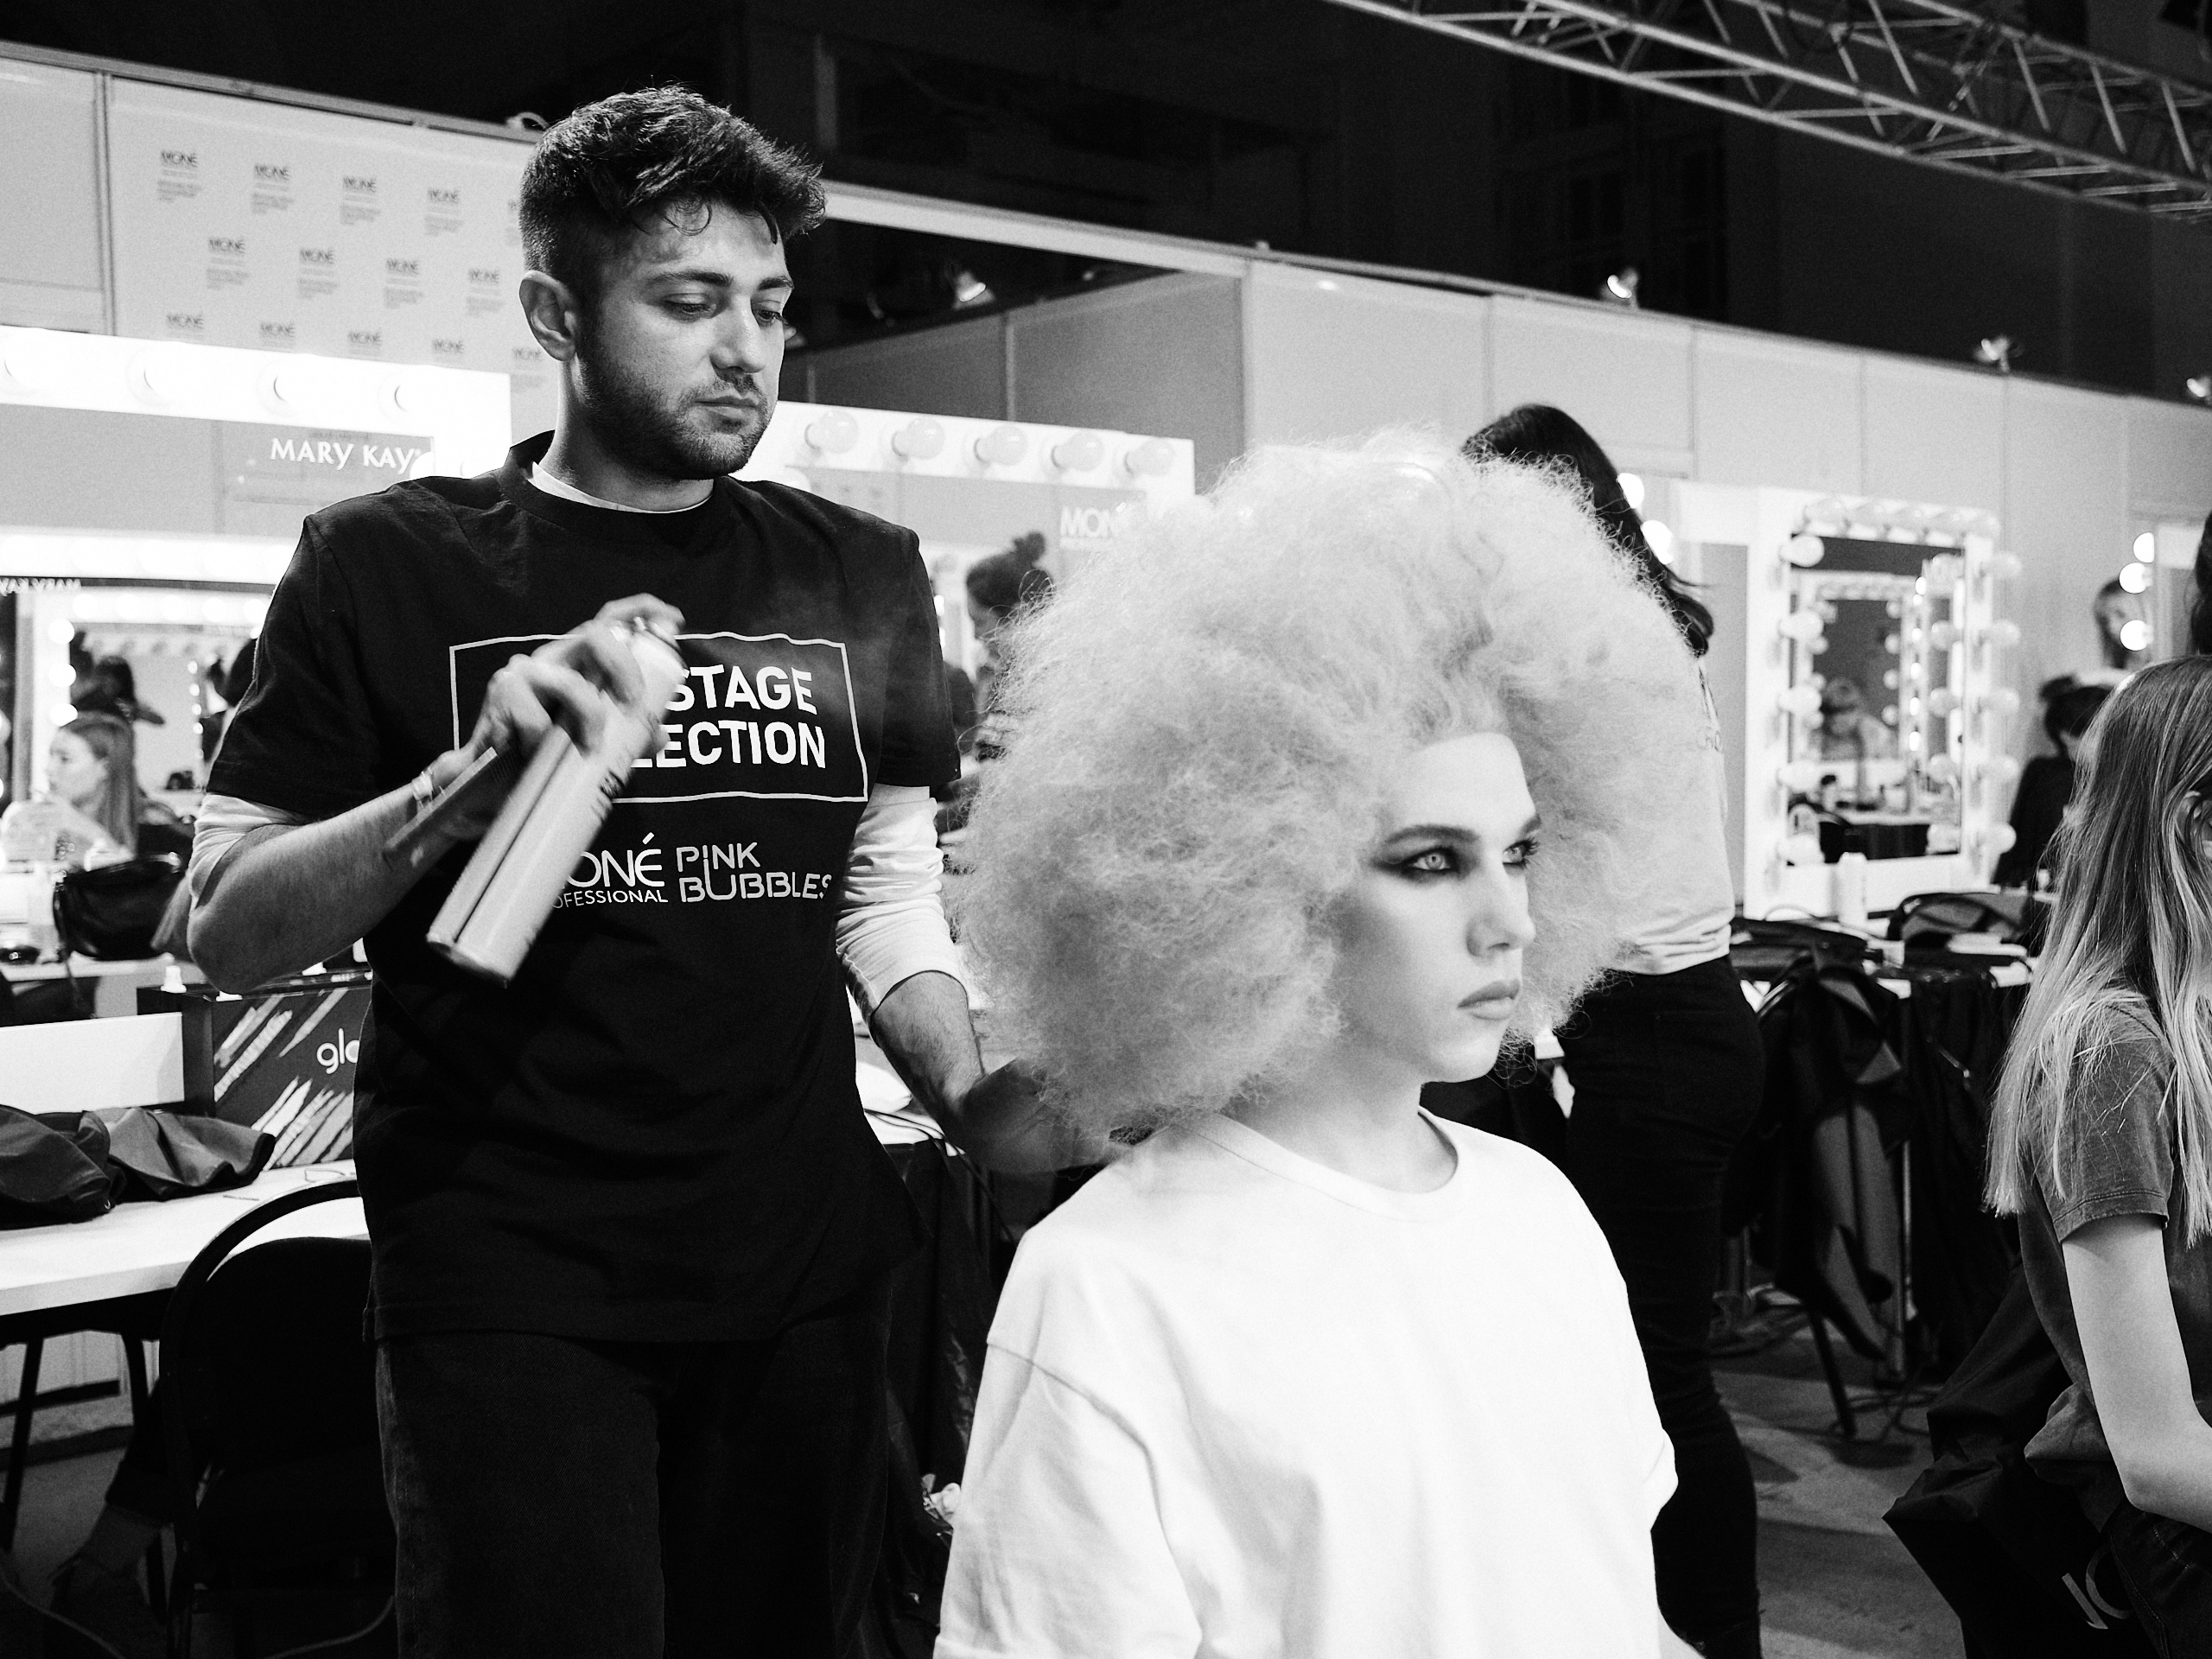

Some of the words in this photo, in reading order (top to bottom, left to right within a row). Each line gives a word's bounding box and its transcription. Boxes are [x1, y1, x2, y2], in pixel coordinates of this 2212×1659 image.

[270, 437, 354, 471] MARY
[1060, 505, 1122, 538] MON
[562, 831, 665, 889] ONÉ
[677, 842, 761, 872] PINK
[551, 888, 669, 909] OFESSIONAL
